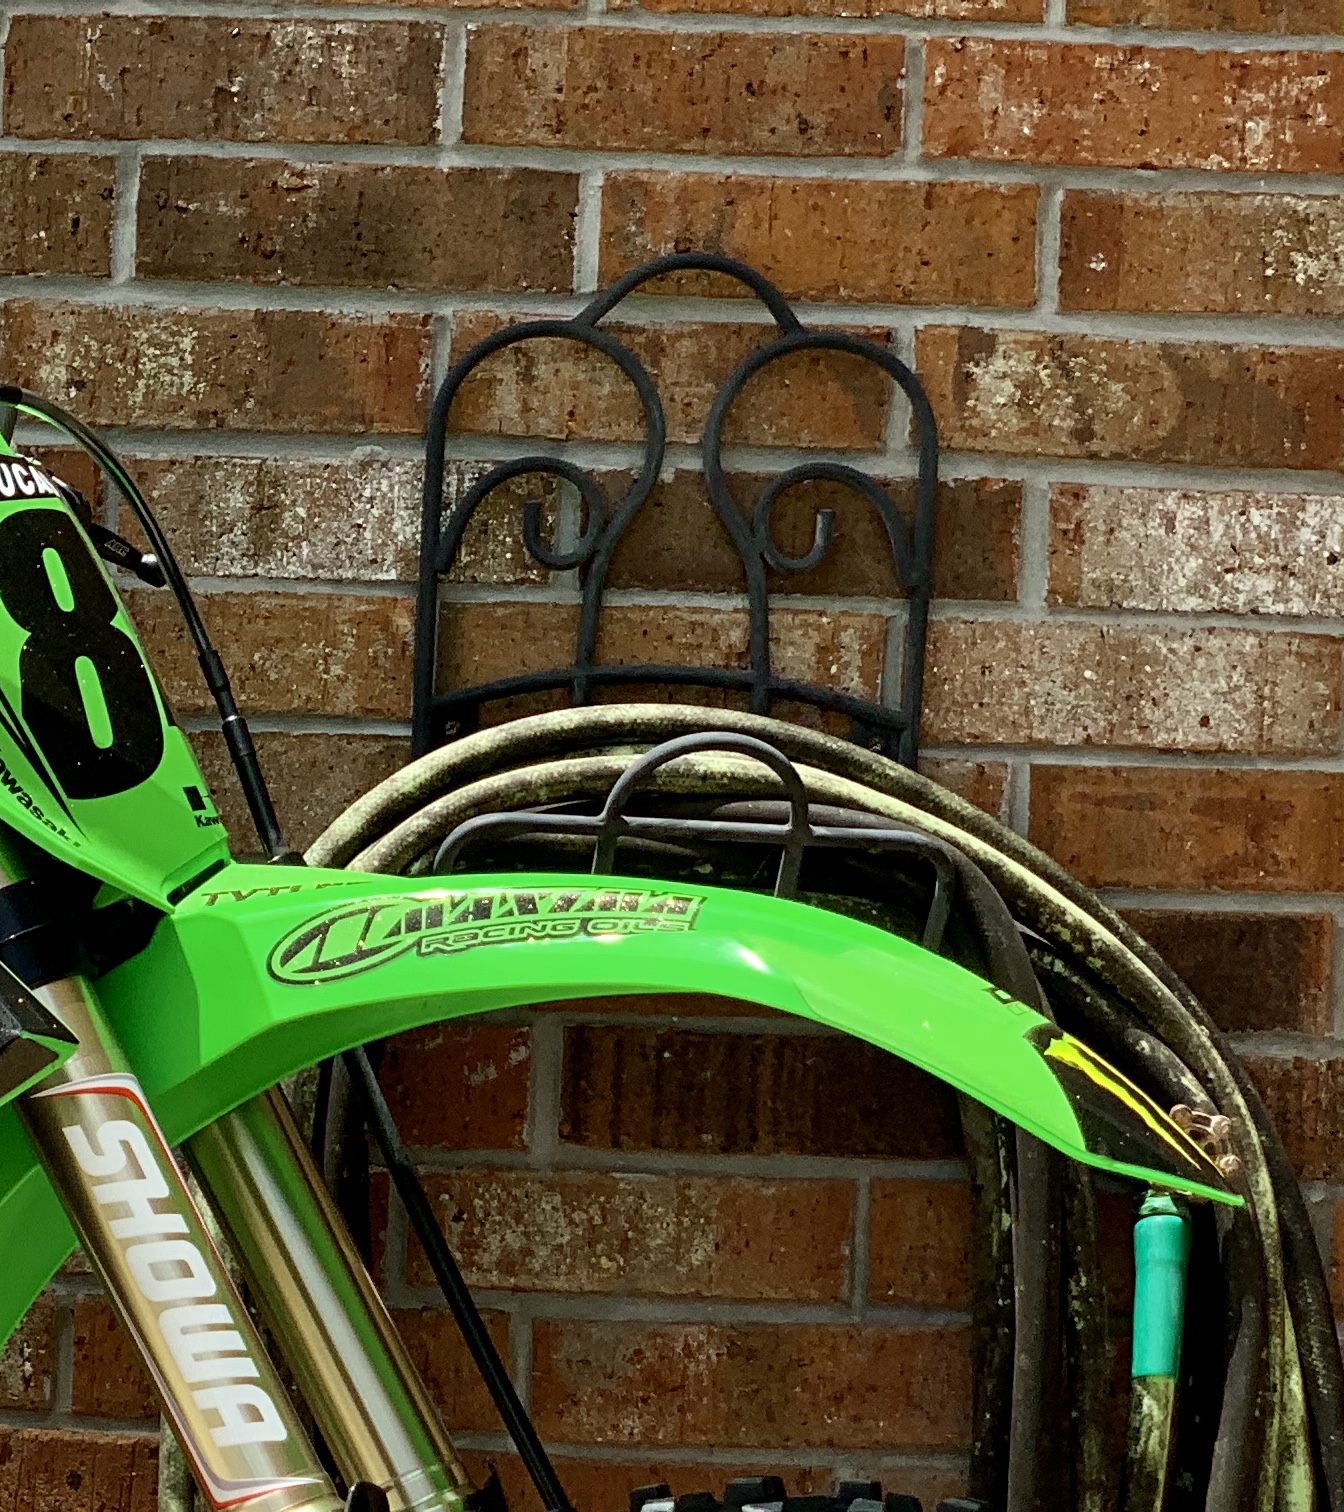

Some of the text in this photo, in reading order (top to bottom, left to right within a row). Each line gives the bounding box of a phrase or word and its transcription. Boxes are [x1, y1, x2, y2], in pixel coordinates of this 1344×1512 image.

[417, 917, 696, 955] RACING OILS
[61, 1118, 288, 1451] SHOWA
